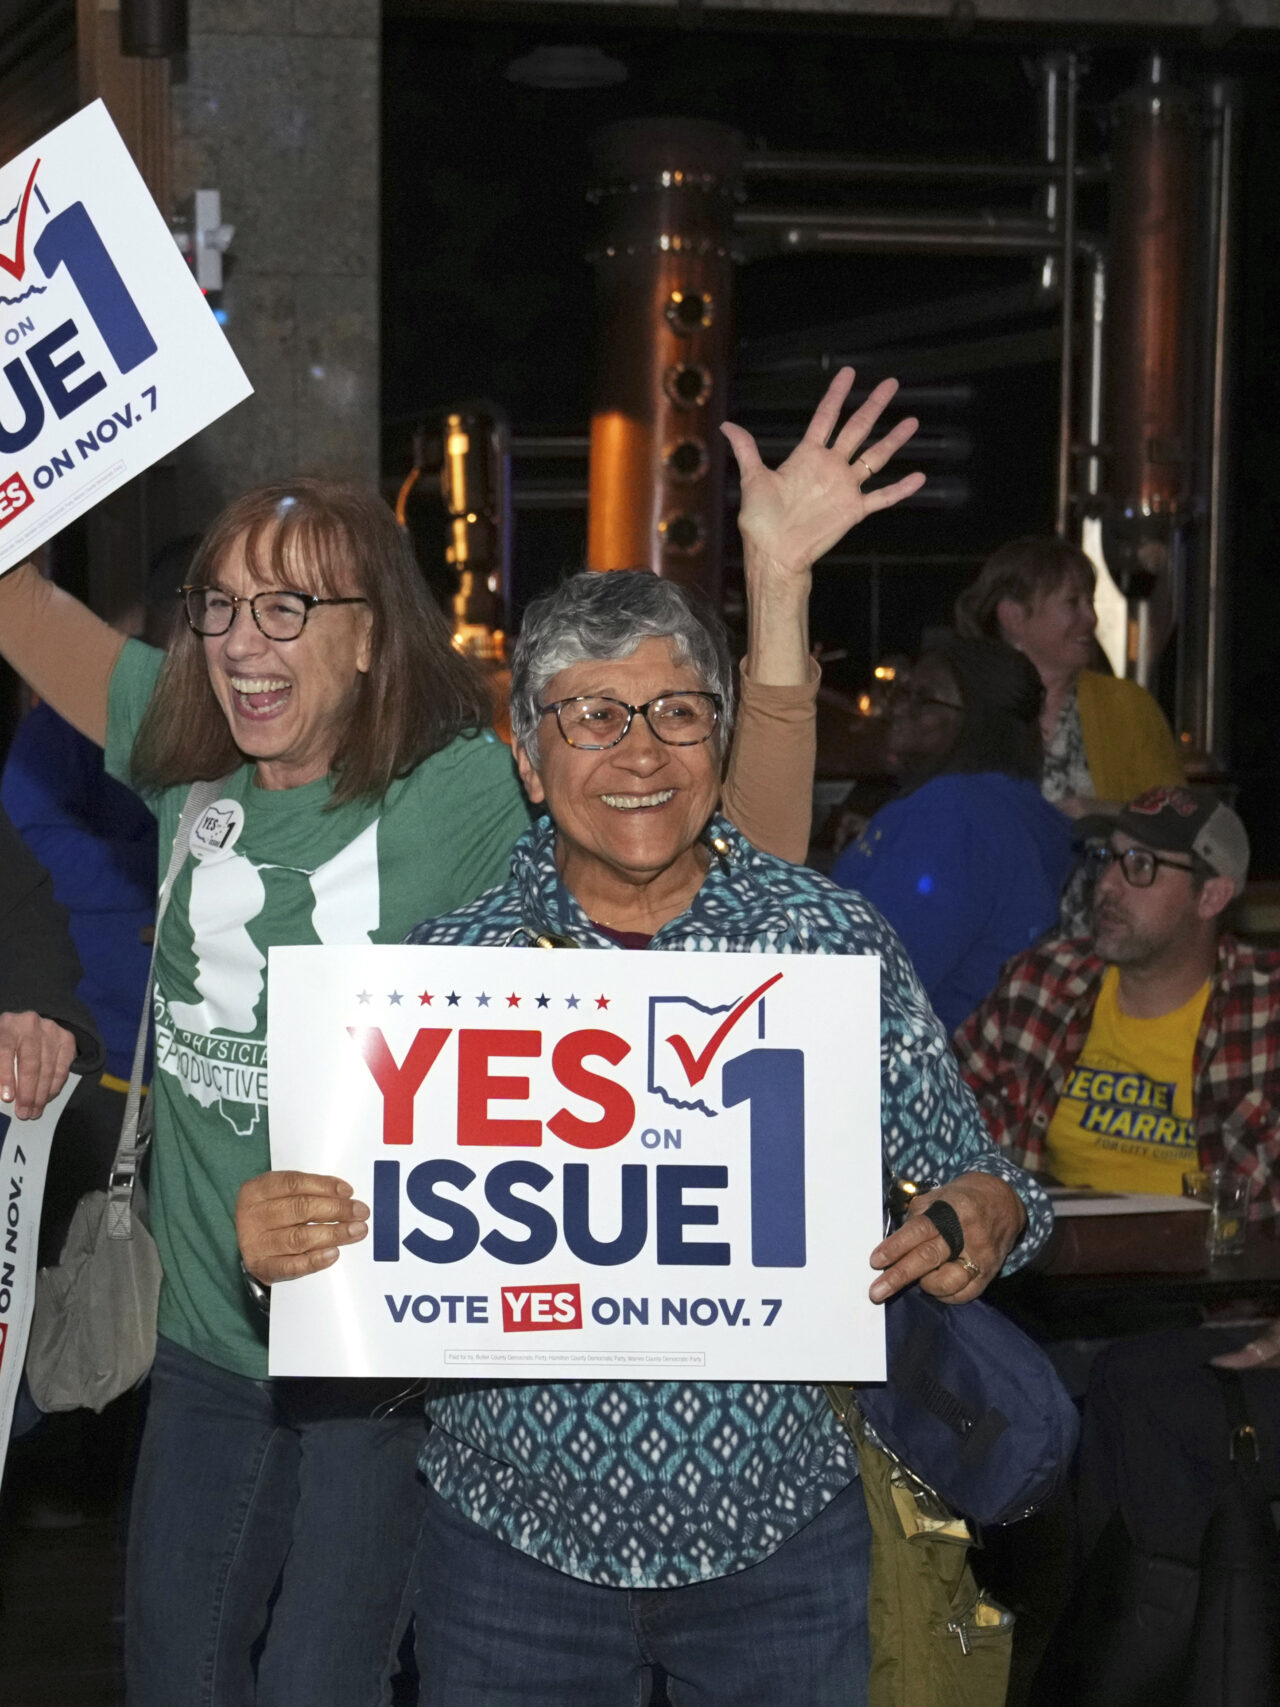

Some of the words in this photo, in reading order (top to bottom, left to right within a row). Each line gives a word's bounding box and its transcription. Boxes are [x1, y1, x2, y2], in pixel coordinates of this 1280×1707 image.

[4, 316, 36, 345] ON
[33, 200, 158, 375] 1
[32, 451, 75, 490] ON
[77, 404, 142, 460] NOV.
[140, 386, 159, 412] 7
[202, 816, 219, 831] YES
[346, 1026, 636, 1149] YES
[640, 1128, 682, 1150] ON
[13, 1145, 27, 1166] 7
[722, 1048, 807, 1268] 1
[3, 1174, 24, 1256] NOV.
[373, 1158, 731, 1267] ISSUE
[384, 1294, 490, 1326] VOTE
[504, 1291, 577, 1325] YES
[591, 1296, 650, 1326] ON
[662, 1297, 751, 1327] NOV.
[761, 1299, 783, 1327] 7
